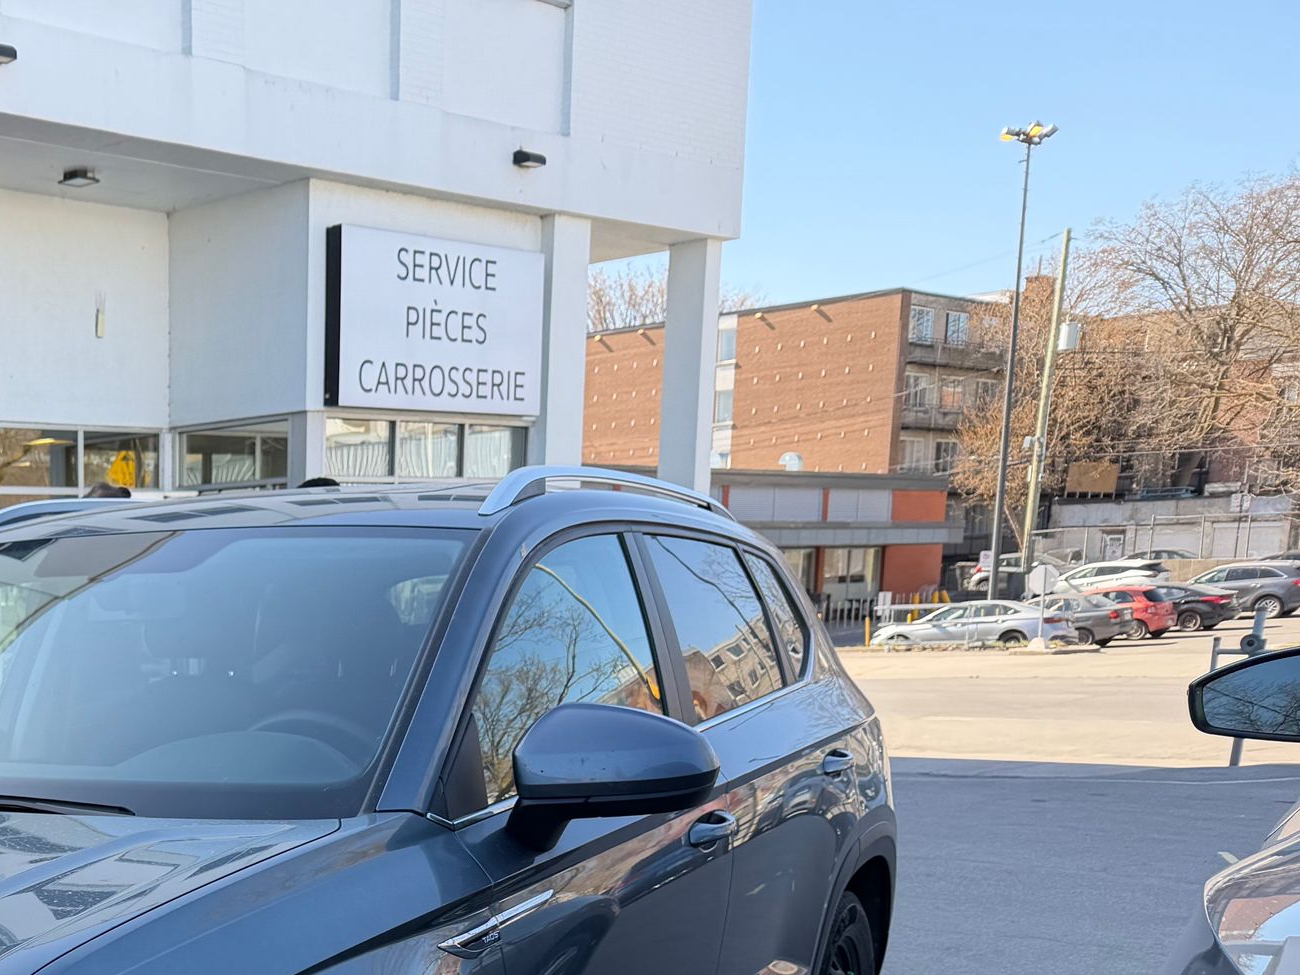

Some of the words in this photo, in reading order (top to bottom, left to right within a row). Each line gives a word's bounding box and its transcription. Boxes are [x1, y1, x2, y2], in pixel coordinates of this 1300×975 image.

[396, 247, 497, 291] SERVICE
[406, 299, 488, 345] PIÈCES
[358, 359, 526, 402] CARROSSERIE
